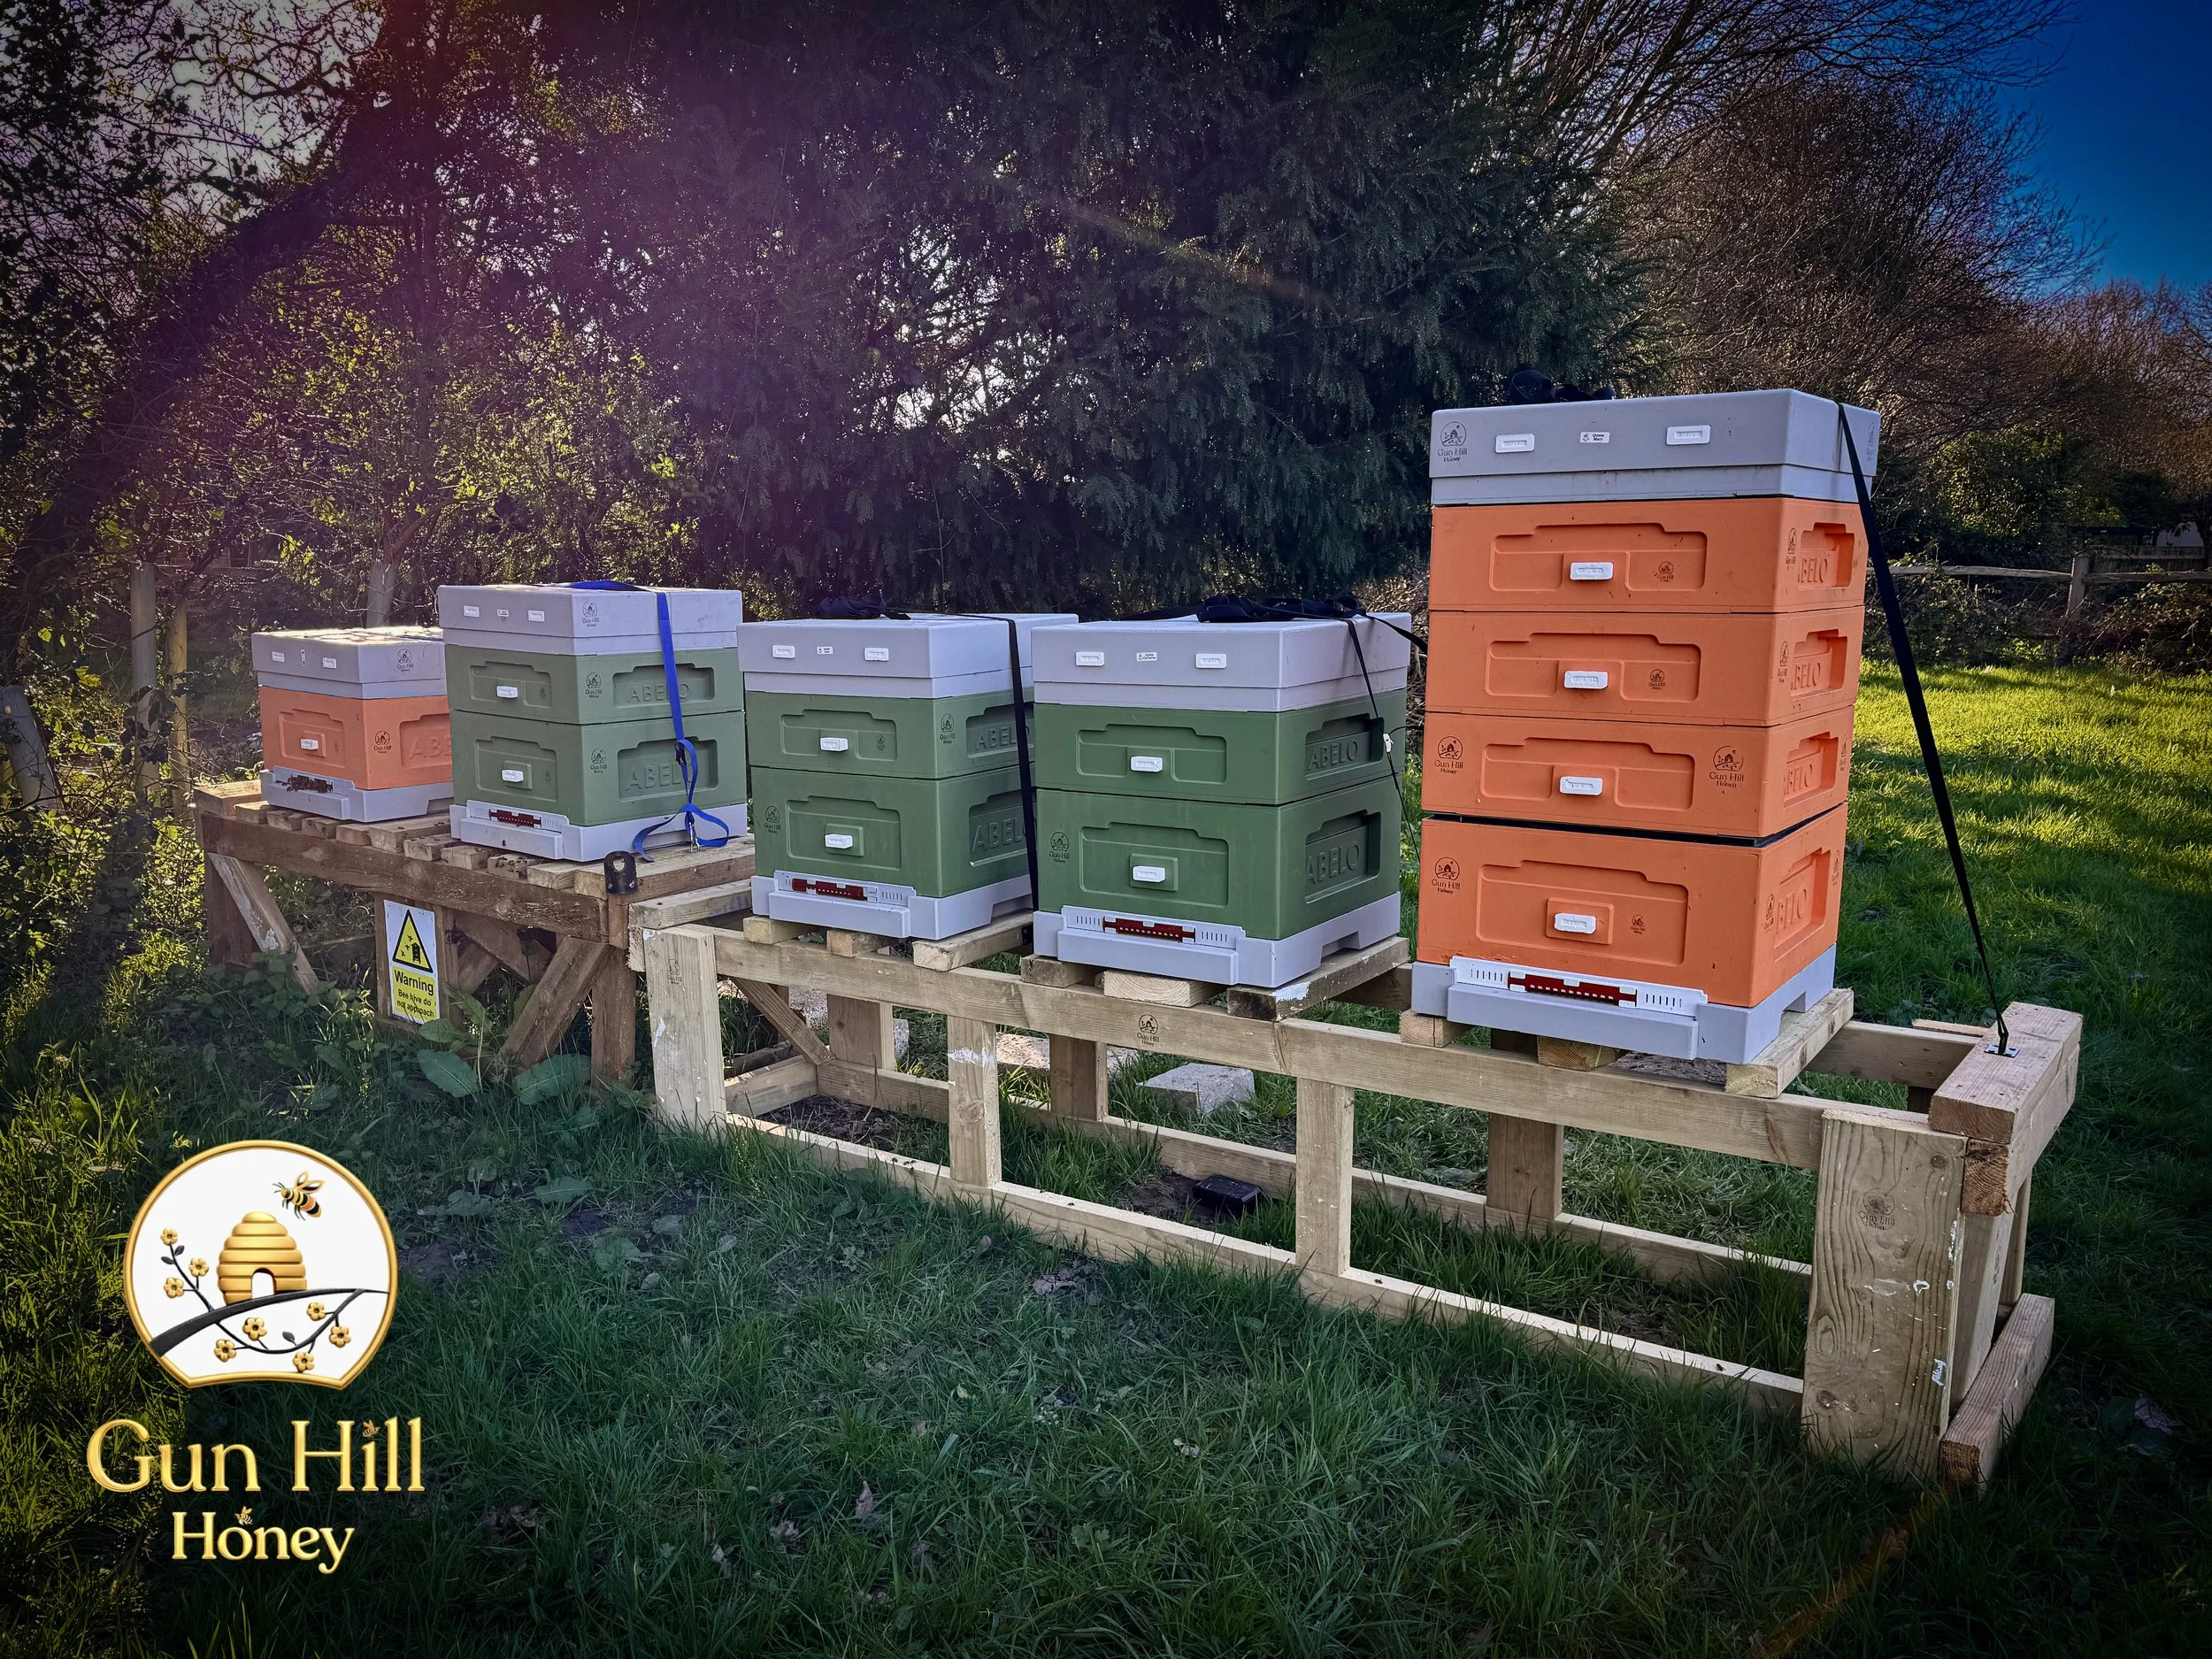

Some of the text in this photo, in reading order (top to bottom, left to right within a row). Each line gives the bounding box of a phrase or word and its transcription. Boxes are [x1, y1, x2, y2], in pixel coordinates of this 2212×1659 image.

[1437, 447, 1468, 457] Gun Hill
[627, 683, 689, 703] ABEO
[1309, 740, 1359, 772] ABELO
[1433, 759, 1464, 770] Gun Hill
[625, 763, 695, 792] ABEL
[1709, 771, 1745, 783] Gun Hill
[972, 814, 1037, 854] ABEL
[1305, 843, 1361, 885] ABELO
[1431, 879, 1448, 888] Gun
[394, 969, 434, 996] Warning
[398, 988, 408, 999] Bee
[423, 997, 432, 1007] do
[407, 1003, 434, 1018] approach
